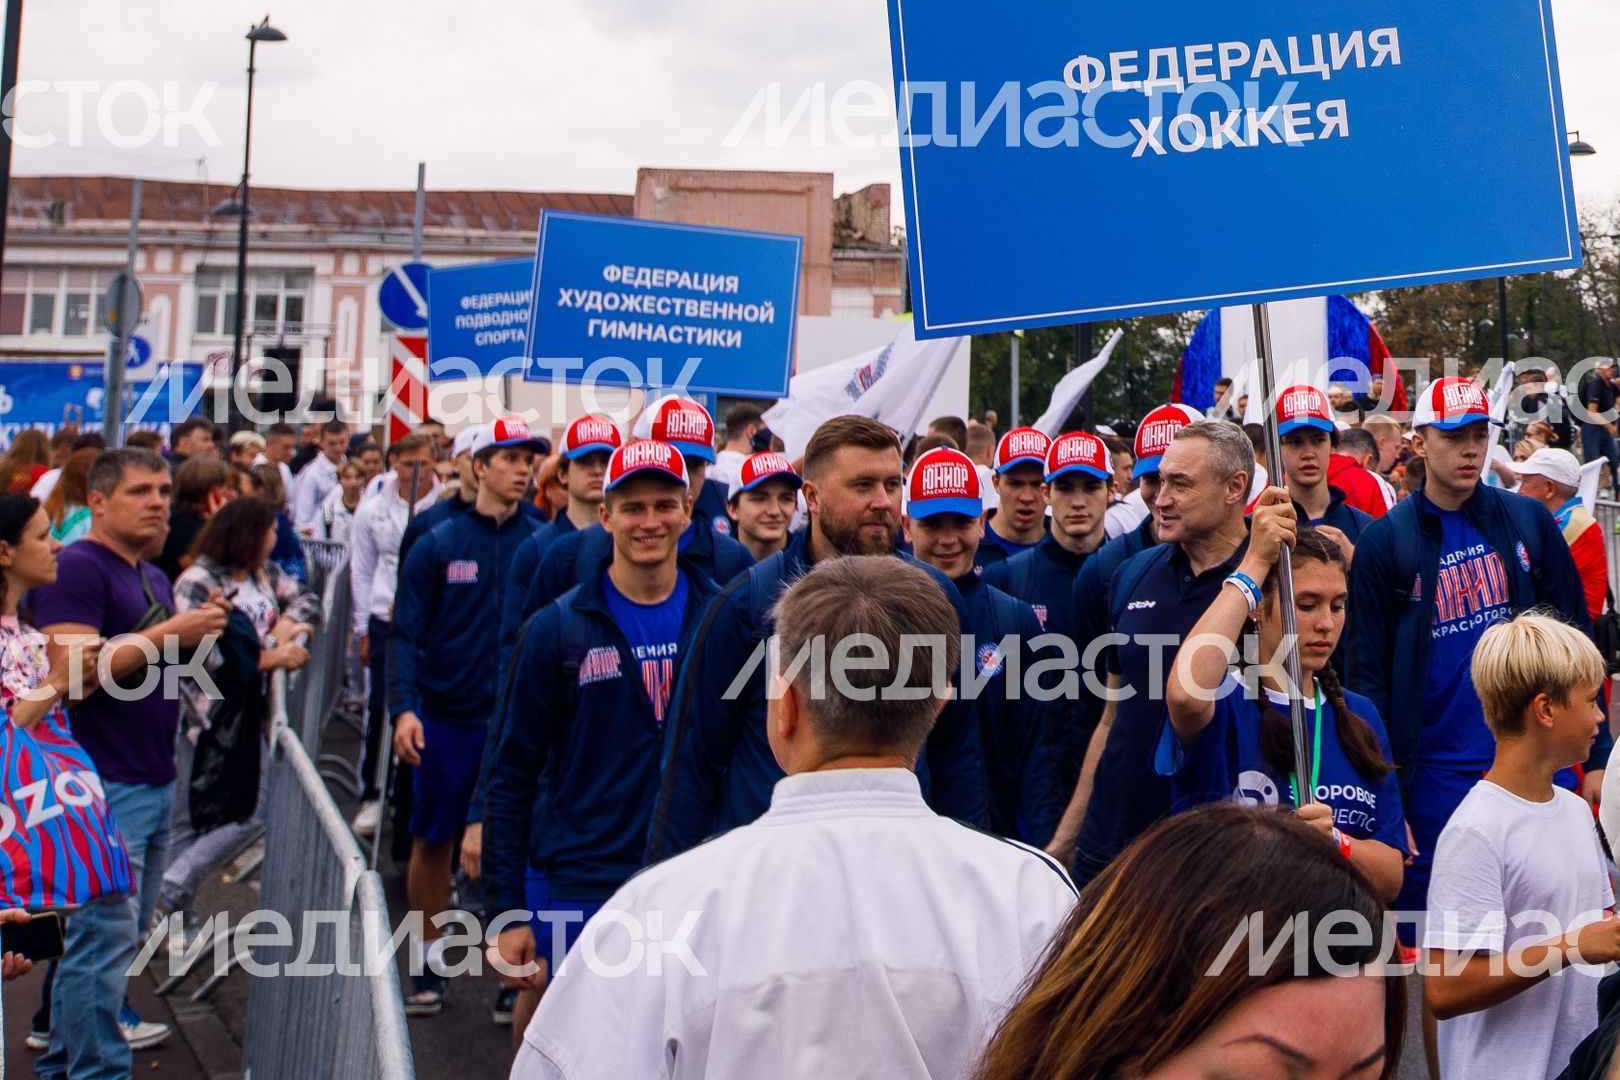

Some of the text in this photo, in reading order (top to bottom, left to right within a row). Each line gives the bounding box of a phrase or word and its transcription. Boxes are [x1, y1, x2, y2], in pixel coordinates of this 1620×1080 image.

[1062, 26, 1402, 97] ФЕДЕРАЦИЯ
[1129, 99, 1350, 158] ХОККЕЯ
[603, 264, 740, 296] ФЕДЕРАЦИЯ
[460, 288, 533, 310] ФЕДЕРАЦИ
[557, 287, 776, 324] ХУДОЖЕСТВЕННОЙ
[454, 308, 529, 330] ПОДВОДНО
[474, 328, 527, 347] СПОРТА
[587, 318, 743, 349] ГИМНАСТИКИ
[622, 442, 673, 466] ЮНИОР
[1009, 434, 1047, 453] ЮНИОР
[1057, 439, 1098, 462] ЮНИОР
[922, 466, 969, 491] ЮНИОР
[922, 487, 968, 496] КРАСНОГОРСК
[1438, 543, 1485, 566] АДЕМИЯ
[1434, 551, 1510, 626] ЮНИО
[1432, 606, 1514, 639] КРАСНОГОР
[631, 642, 678, 660] ЕМИЯ
[1289, 784, 1377, 809] ОРОВОЕ
